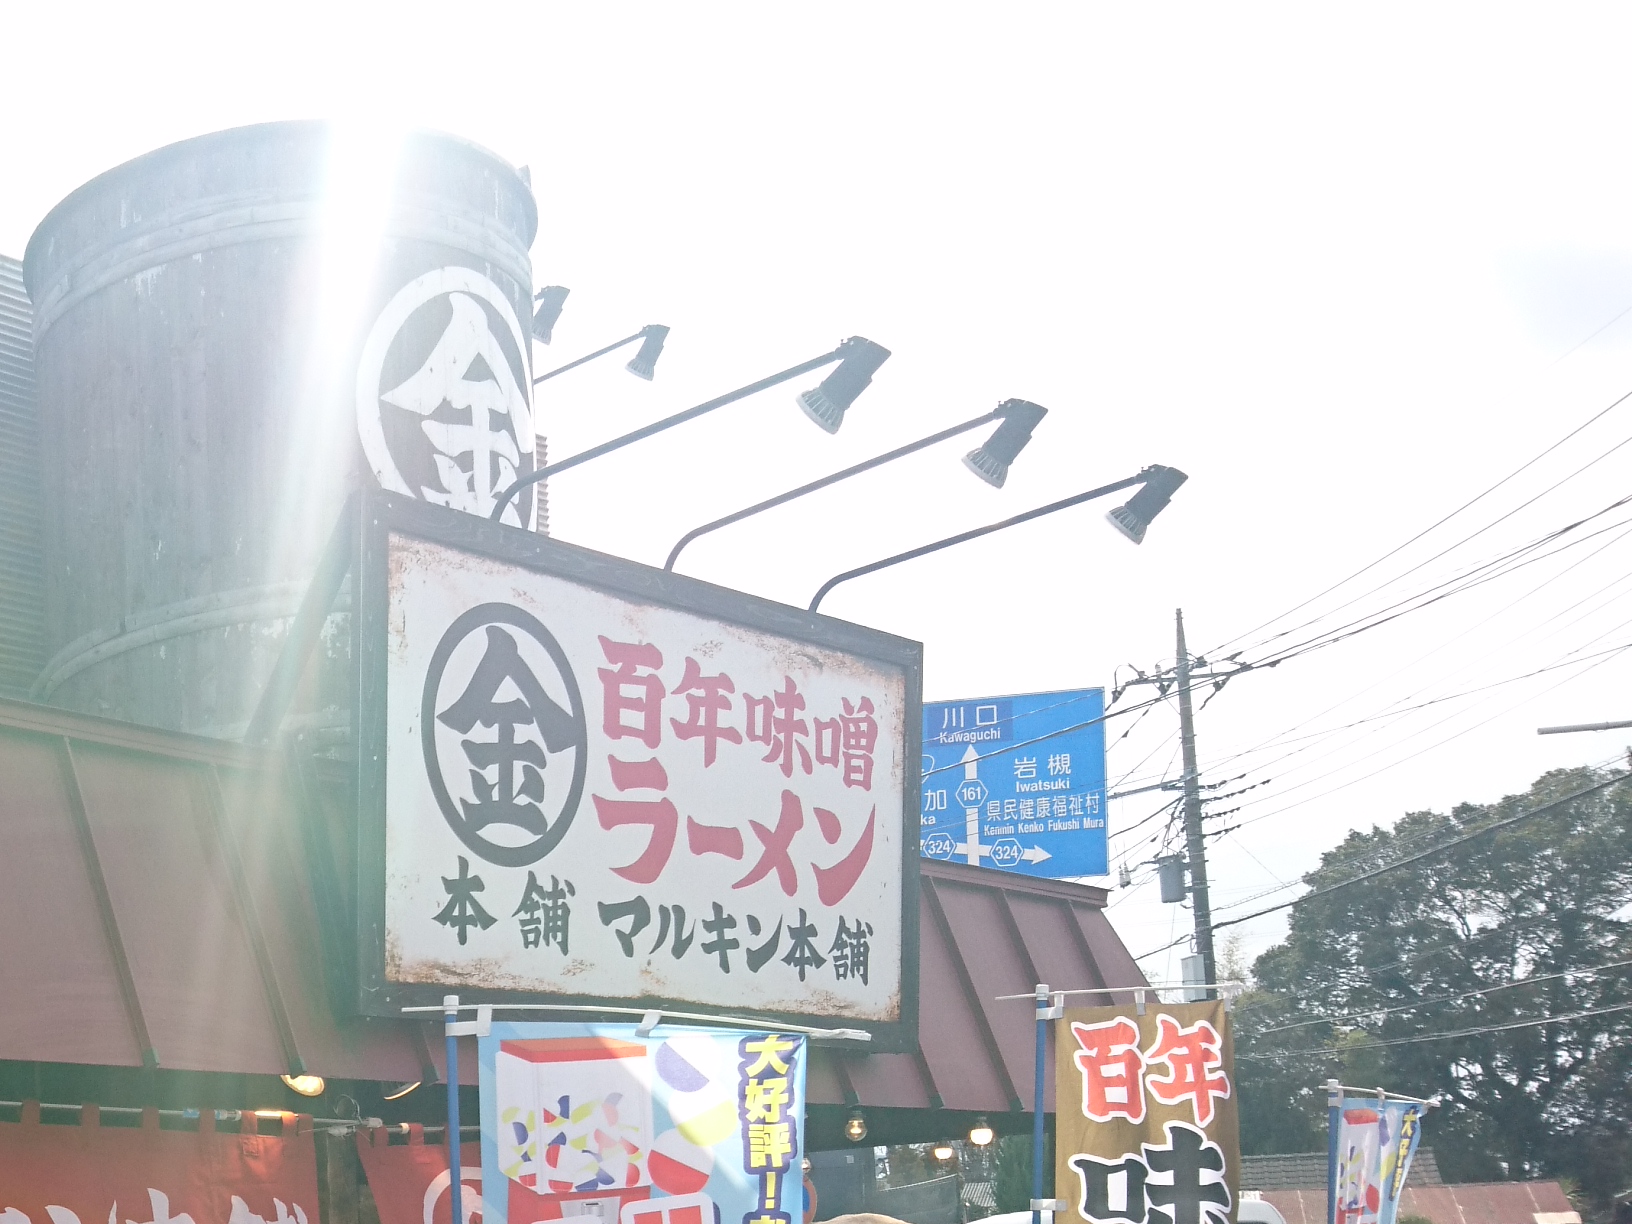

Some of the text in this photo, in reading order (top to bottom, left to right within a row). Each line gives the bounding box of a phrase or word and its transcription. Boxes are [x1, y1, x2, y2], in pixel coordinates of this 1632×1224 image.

[598, 635, 877, 790] 百年味噌
[942, 705, 998, 728] 川口
[940, 728, 1001, 744] Kawaguchi
[1014, 754, 1071, 779] 岩槻
[962, 787, 982, 802] 161
[1015, 778, 1070, 793] Iwatsuki
[987, 793, 1100, 821] 県民健康福祉村
[592, 754, 877, 907] ラーメン
[1018, 821, 1044, 834] Kenko
[1048, 818, 1080, 832] Fukushi
[1083, 817, 1104, 830] Mura
[928, 840, 950, 855] 324
[995, 844, 1018, 859] 324
[598, 895, 874, 986] マルキン本舗
[1076, 1019, 1228, 1122] 百年
